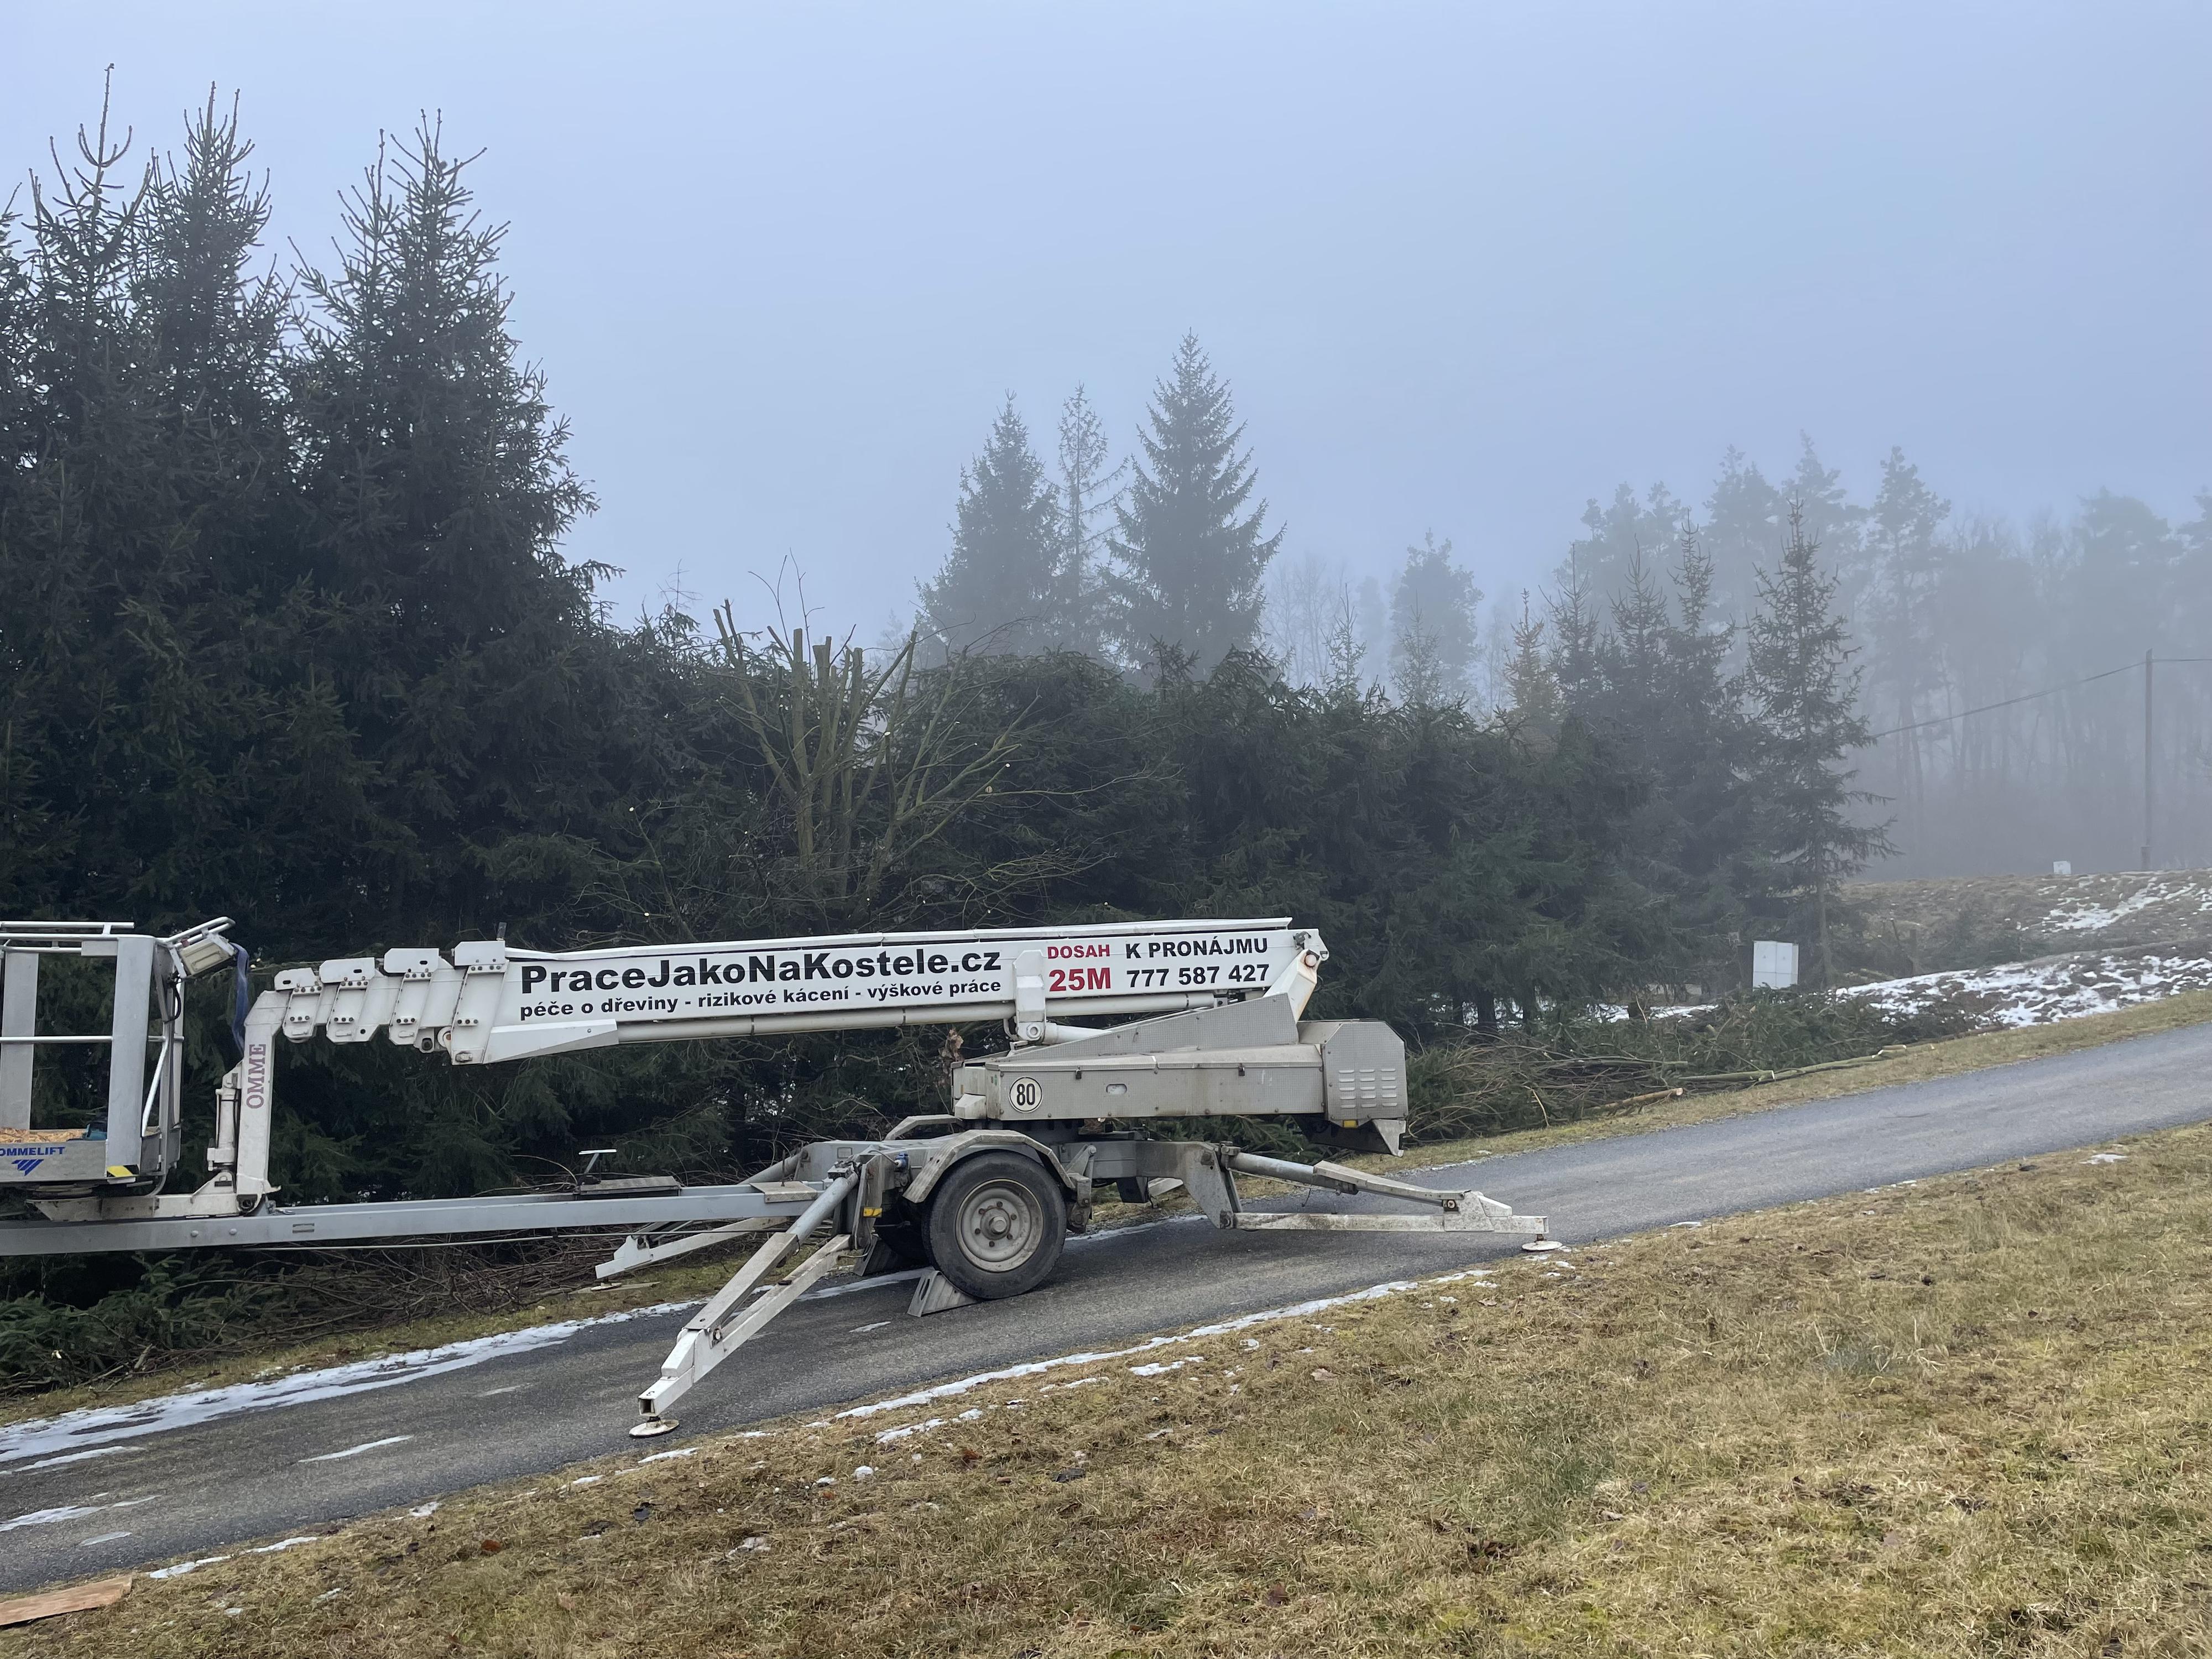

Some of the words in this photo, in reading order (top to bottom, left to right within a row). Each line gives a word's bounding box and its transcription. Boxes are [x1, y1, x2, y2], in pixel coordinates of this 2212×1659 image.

[1047, 945, 1110, 959] DOSAH
[1125, 943, 1141, 959] K
[1148, 936, 1267, 958] PRONÁJMU
[521, 948, 1001, 994] PraceJakoNaKostele.cz
[1049, 967, 1111, 992] 25M
[1126, 968, 1169, 988] 777
[1178, 966, 1220, 985] 587
[1228, 964, 1269, 982] 427
[520, 1001, 573, 1021] péče
[581, 1003, 593, 1014] o
[601, 996, 679, 1013] dřeviny
[698, 989, 776, 1008] rizikové
[784, 987, 849, 1003] kácení
[867, 981, 943, 1001] výškové
[950, 979, 1001, 998] práce
[246, 1044, 266, 1109] OMME
[1016, 1083, 1035, 1106] 80
